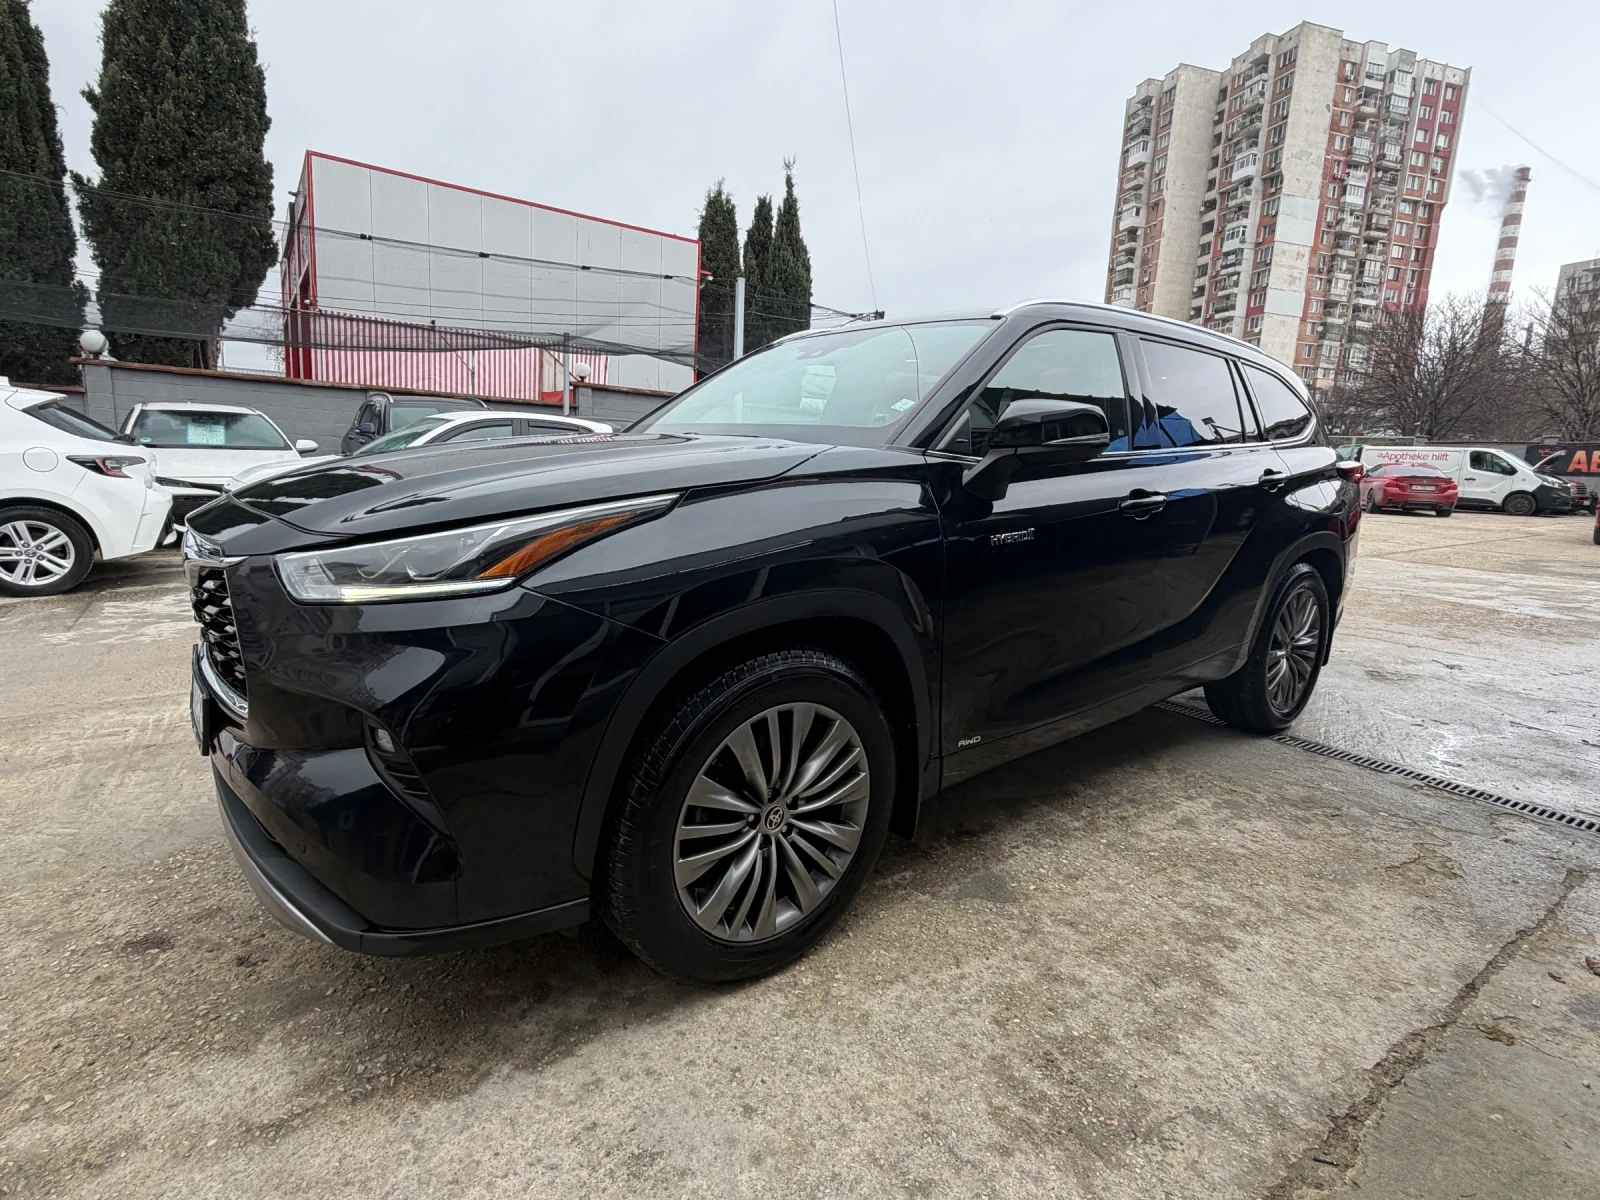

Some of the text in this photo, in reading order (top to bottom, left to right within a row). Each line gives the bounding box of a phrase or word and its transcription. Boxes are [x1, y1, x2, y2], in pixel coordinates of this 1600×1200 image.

[1383, 452, 1429, 461] Apotheke
[1431, 452, 1449, 461] hilft
[990, 530, 1028, 546] HYBRID
[957, 735, 981, 748] AWD
